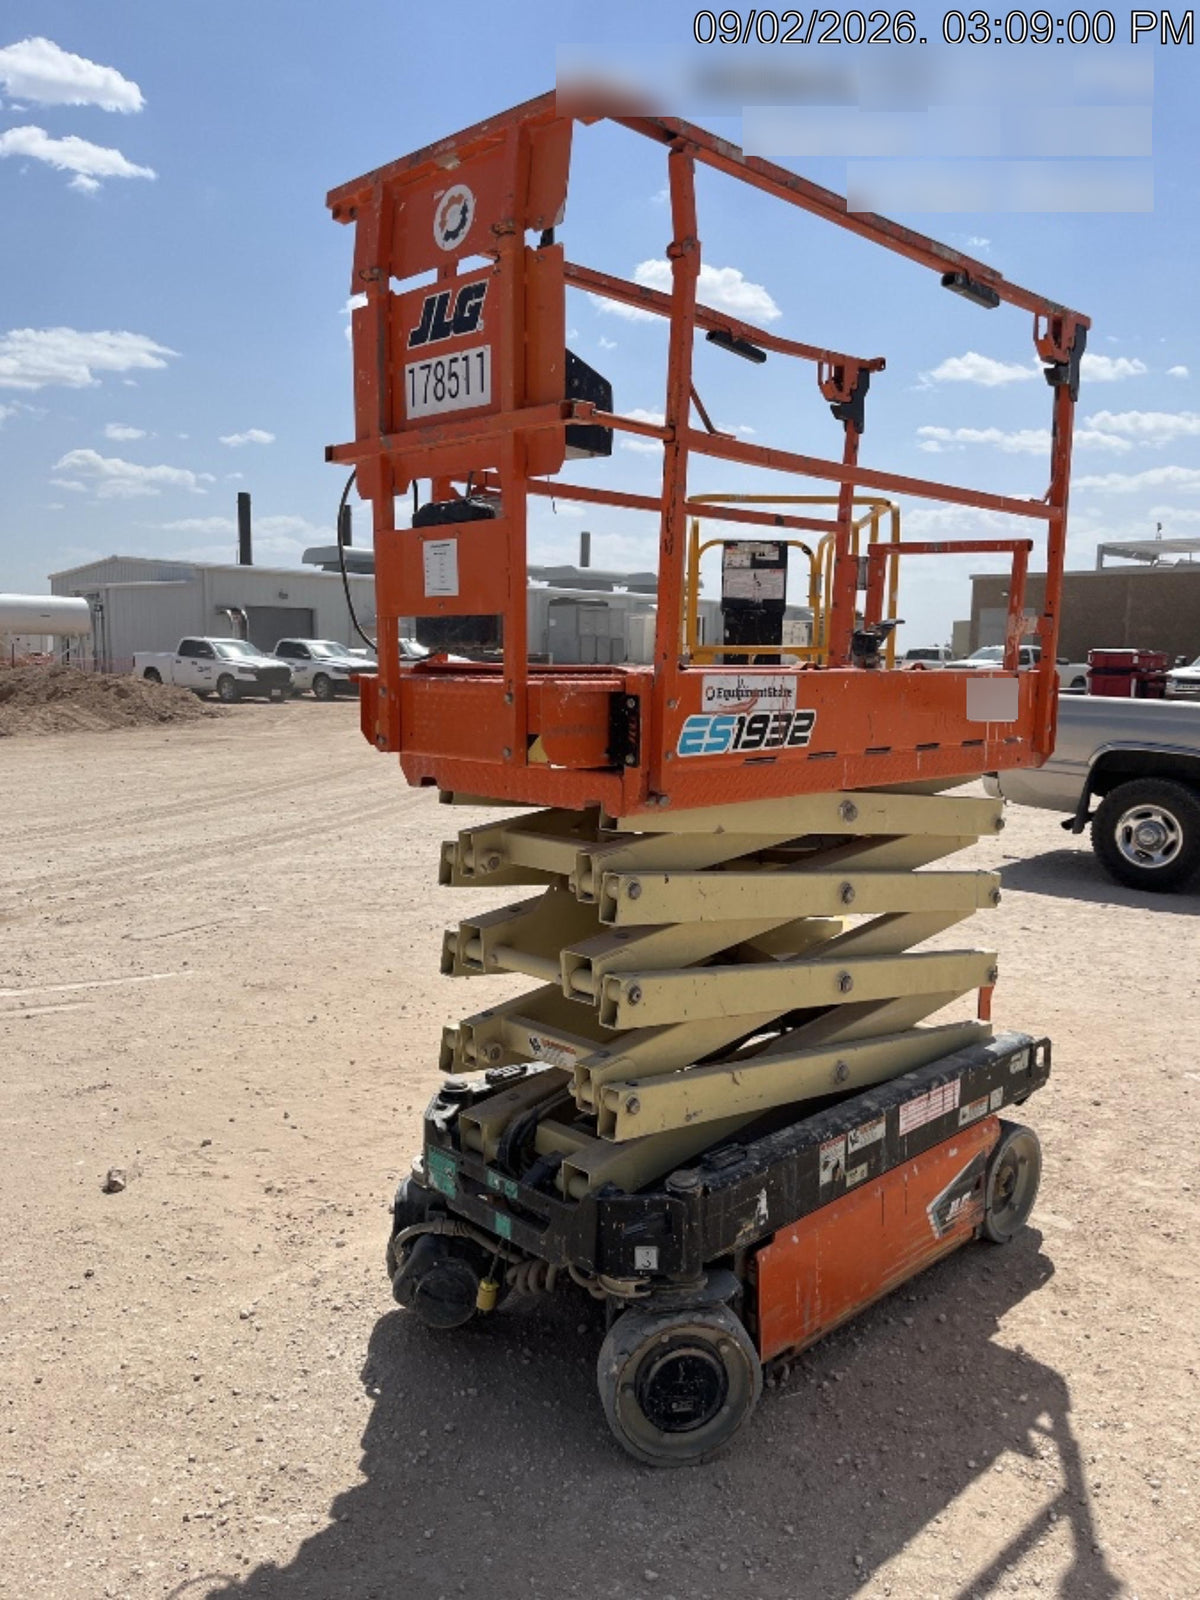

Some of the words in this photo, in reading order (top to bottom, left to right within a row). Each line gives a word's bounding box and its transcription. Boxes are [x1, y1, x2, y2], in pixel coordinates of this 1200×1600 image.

[408, 281, 488, 349] JLG
[408, 351, 485, 407] 178511
[678, 711, 815, 755] ES1932
